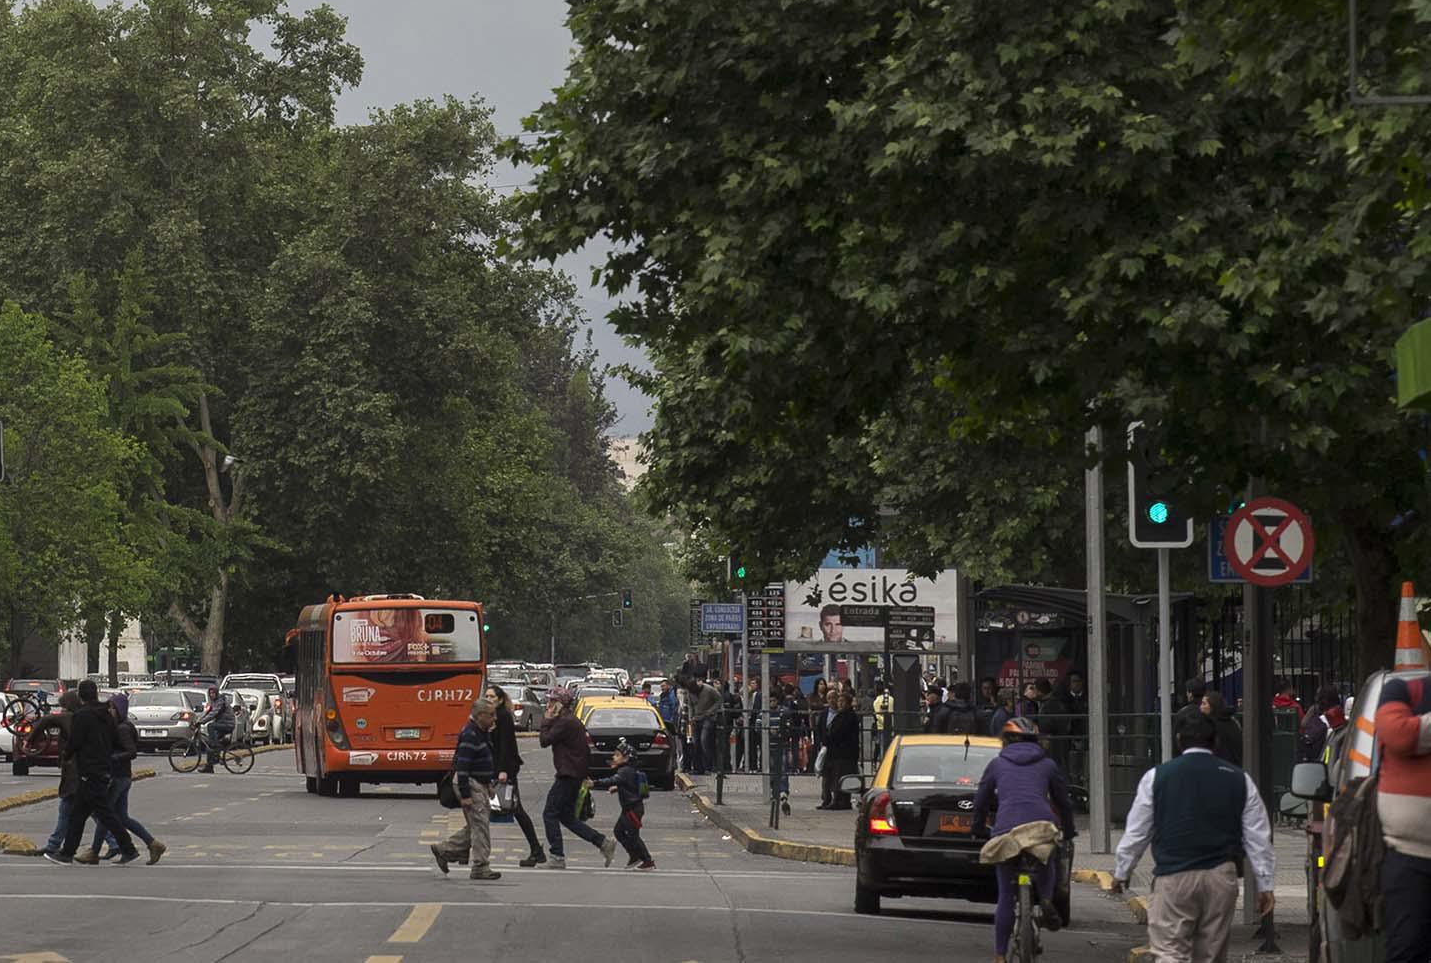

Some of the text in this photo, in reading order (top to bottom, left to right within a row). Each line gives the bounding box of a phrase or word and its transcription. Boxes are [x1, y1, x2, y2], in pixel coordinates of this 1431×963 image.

[829, 573, 917, 605] ésika
[843, 607, 880, 615] Entrada
[351, 625, 380, 643] BRUNA
[418, 689, 473, 702] CJRH72
